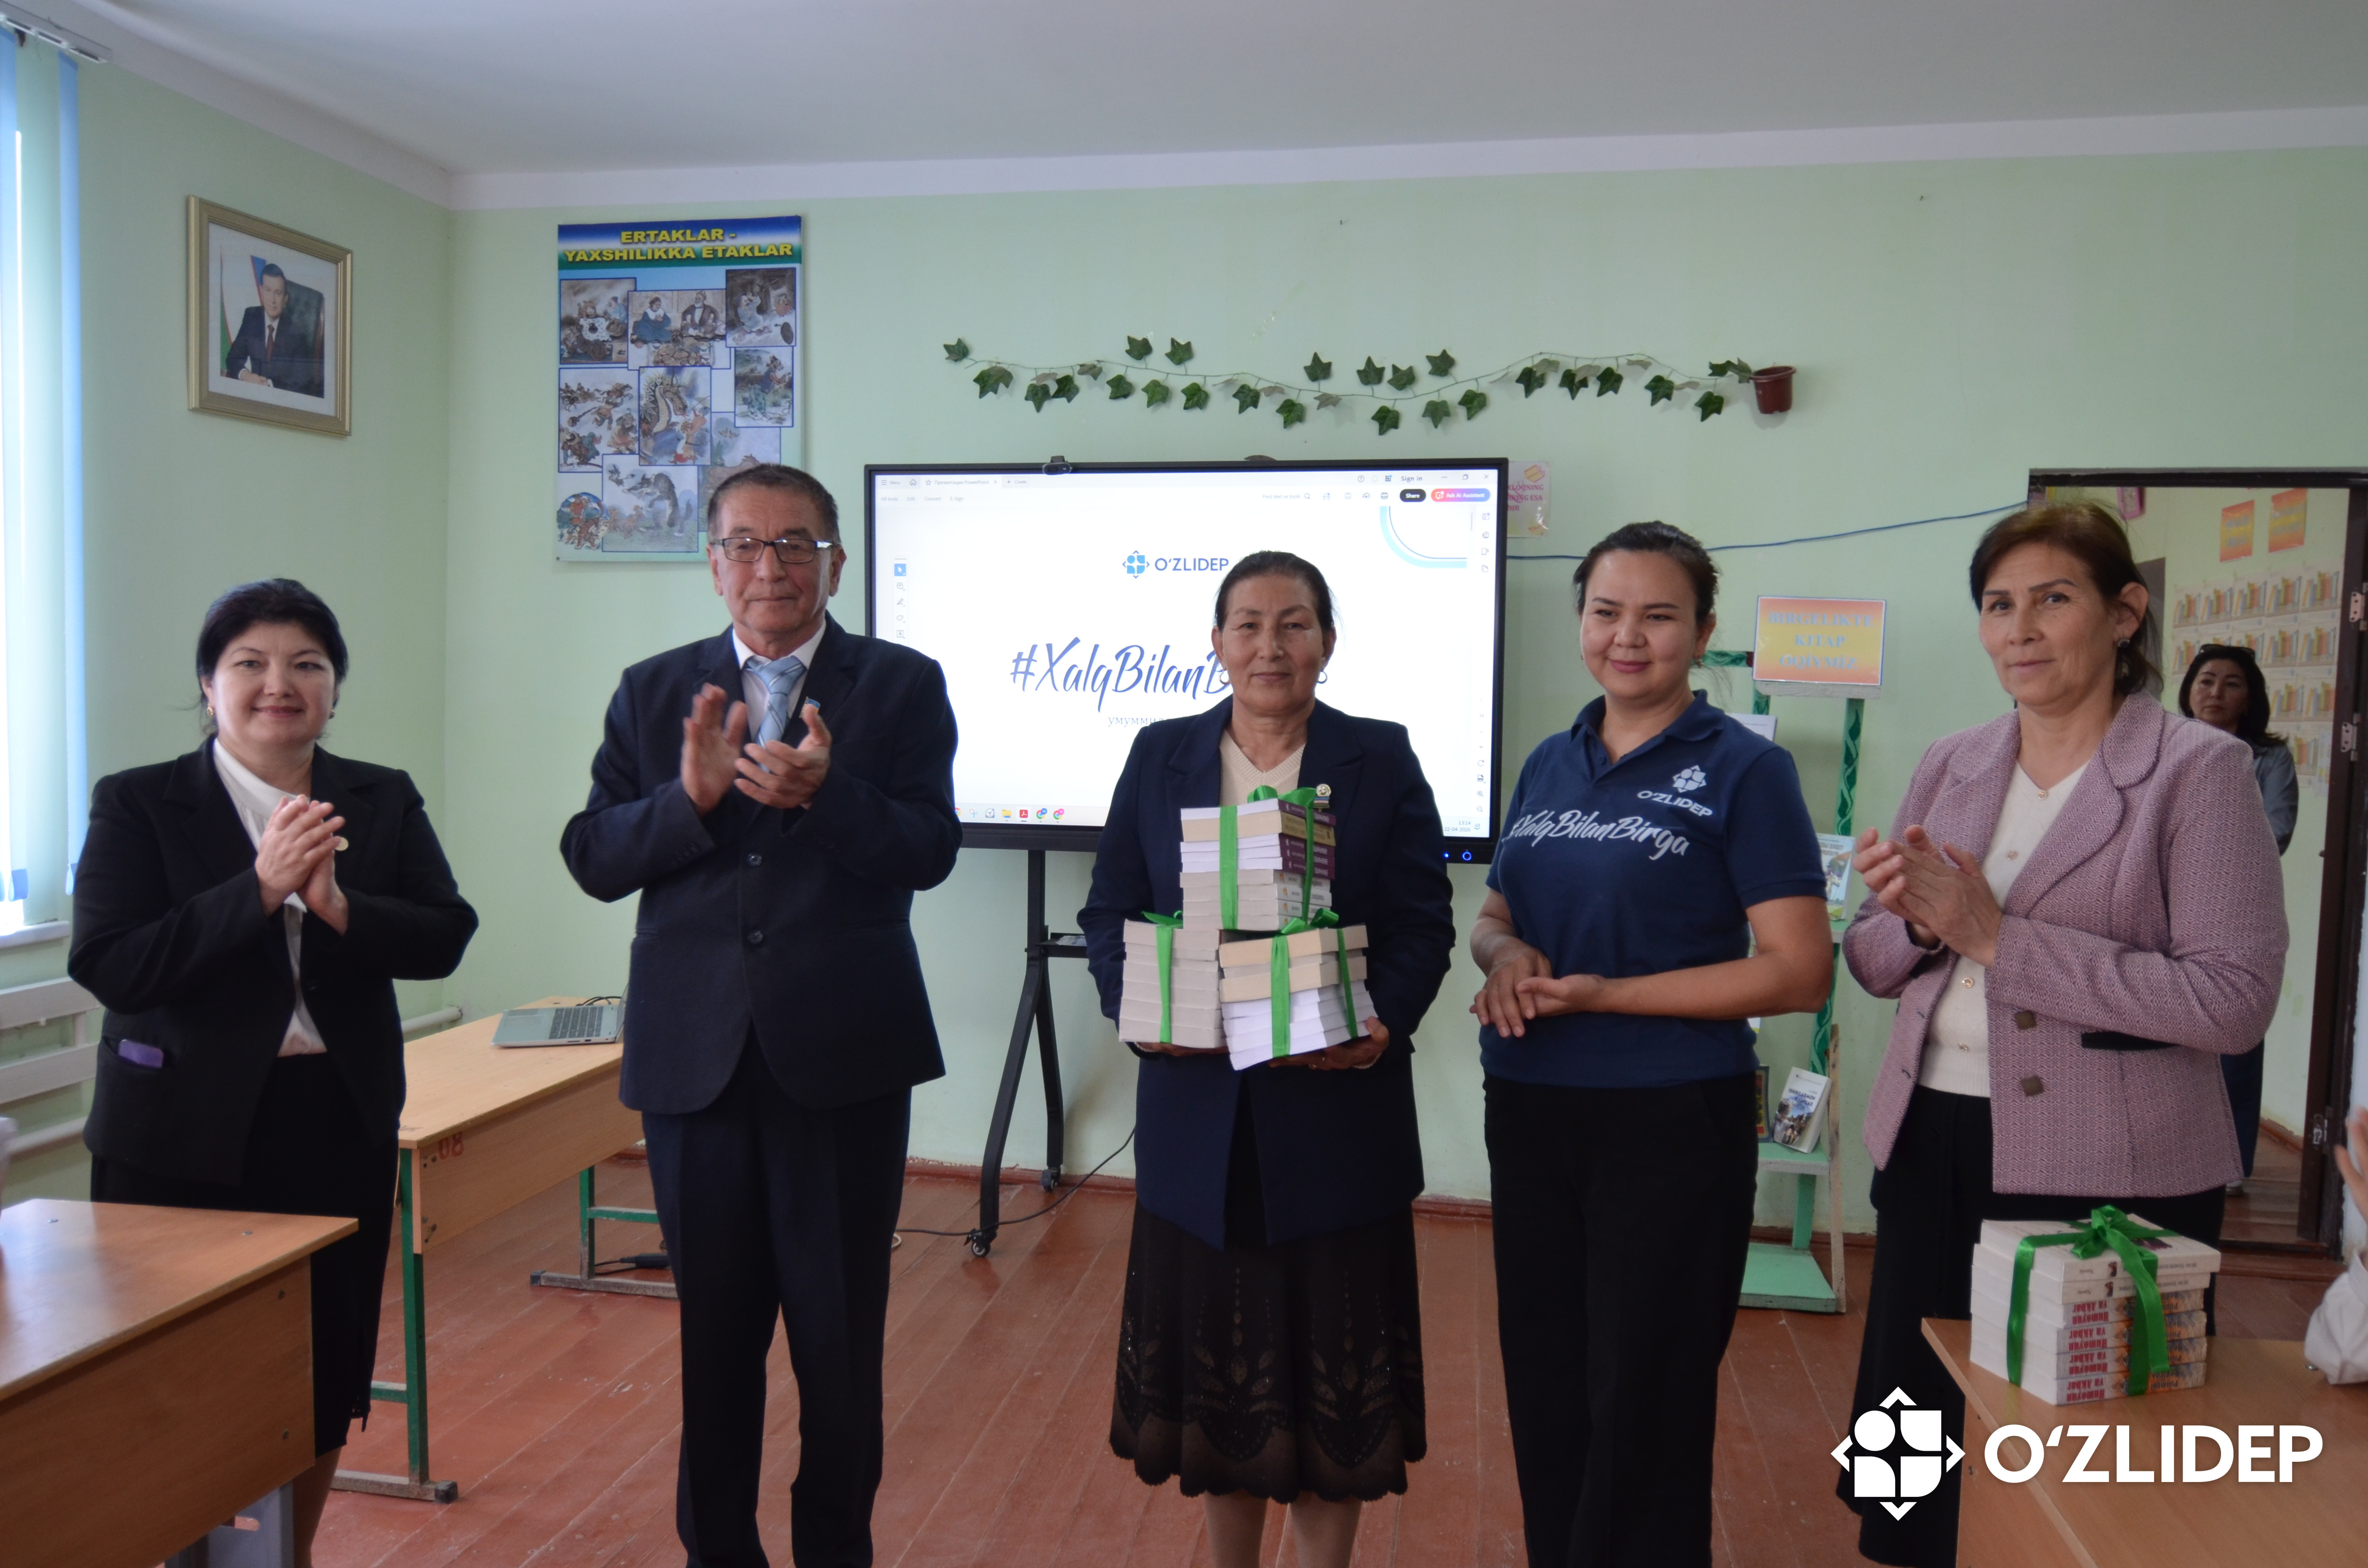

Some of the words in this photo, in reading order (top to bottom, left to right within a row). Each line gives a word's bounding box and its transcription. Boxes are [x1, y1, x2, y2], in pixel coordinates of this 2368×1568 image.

[621, 229, 724, 243] ERTAKLAR
[564, 247, 695, 262] YAXSHILIKKA
[702, 244, 792, 258] ETAKLAR
[1155, 558, 1229, 571] O‘ZLIDEP
[1769, 612, 1874, 627] BIRGELIKTE
[1795, 634, 1847, 648] KITAP
[1010, 637, 1232, 713] #XalqBilanB
[2072, 1301, 2096, 1312] Akbar
[2099, 1300, 2107, 1309] va
[2072, 1311, 2109, 1324] Humoyun
[2069, 1328, 2094, 1339] Akbar
[2097, 1327, 2106, 1335] va
[2069, 1338, 2107, 1351] Humoyun
[2070, 1353, 2095, 1363] Akbar
[2097, 1351, 2106, 1360] va
[2069, 1362, 2108, 1375] Humoyun
[2067, 1379, 2092, 1390] Akbar
[2095, 1378, 2104, 1386] va
[2067, 1389, 2105, 1402] Humoyun
